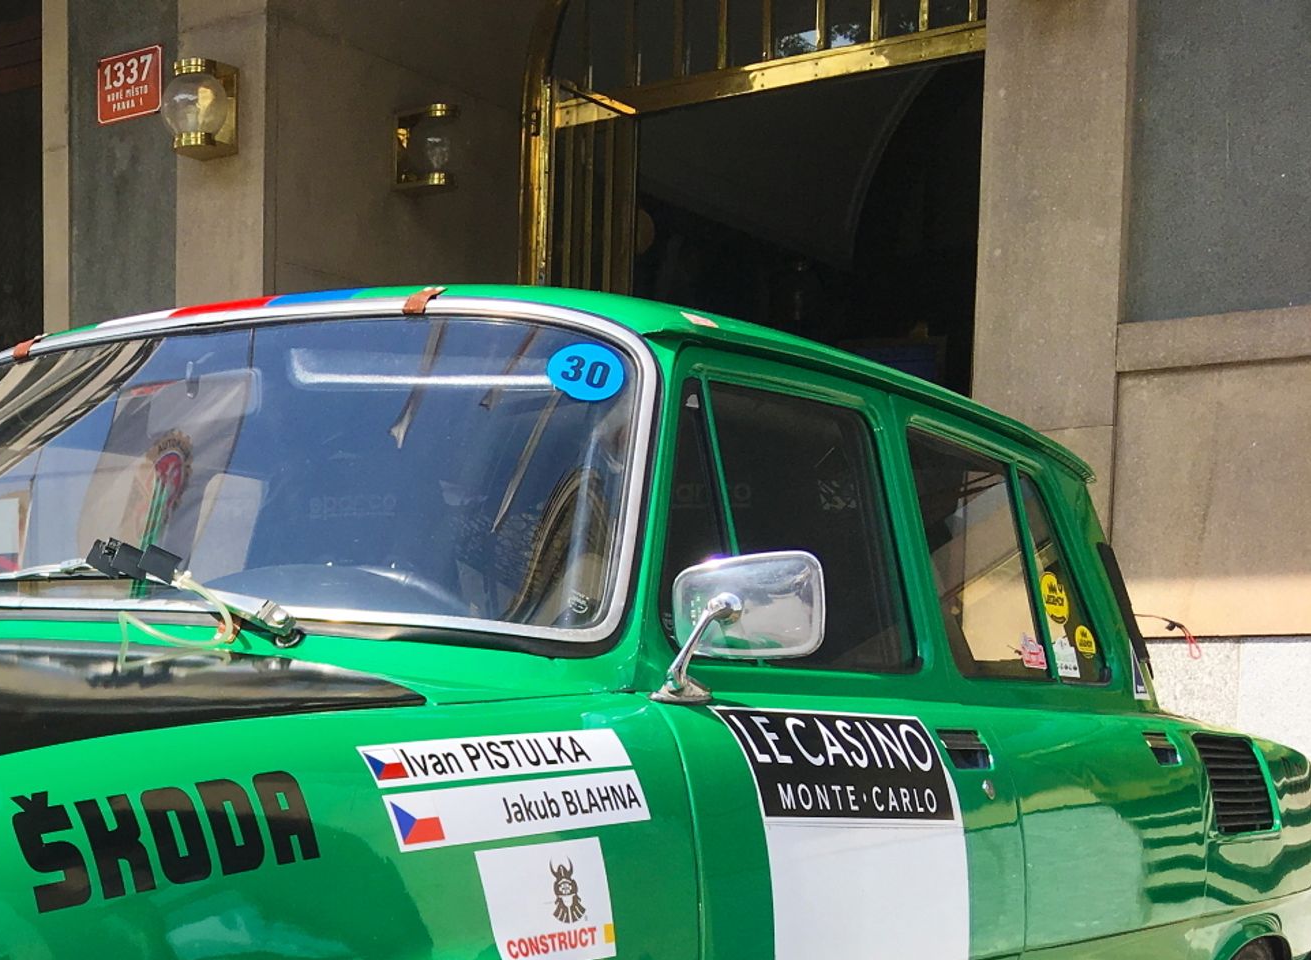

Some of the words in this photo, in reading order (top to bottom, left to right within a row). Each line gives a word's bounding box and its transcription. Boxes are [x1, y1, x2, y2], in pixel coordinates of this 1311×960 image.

[104, 54, 153, 90] 1337
[113, 98, 135, 112] PRAHA
[561, 355, 611, 389] 30
[399, 748, 464, 777] Ivan
[460, 735, 592, 771] PISTULKA
[728, 714, 793, 764] LE
[784, 717, 933, 773] CASINO
[502, 791, 562, 825] Jakub
[561, 783, 642, 816] BLAHNA
[10, 770, 321, 914] ŠKODA
[506, 927, 597, 960] CONSTRUCT
